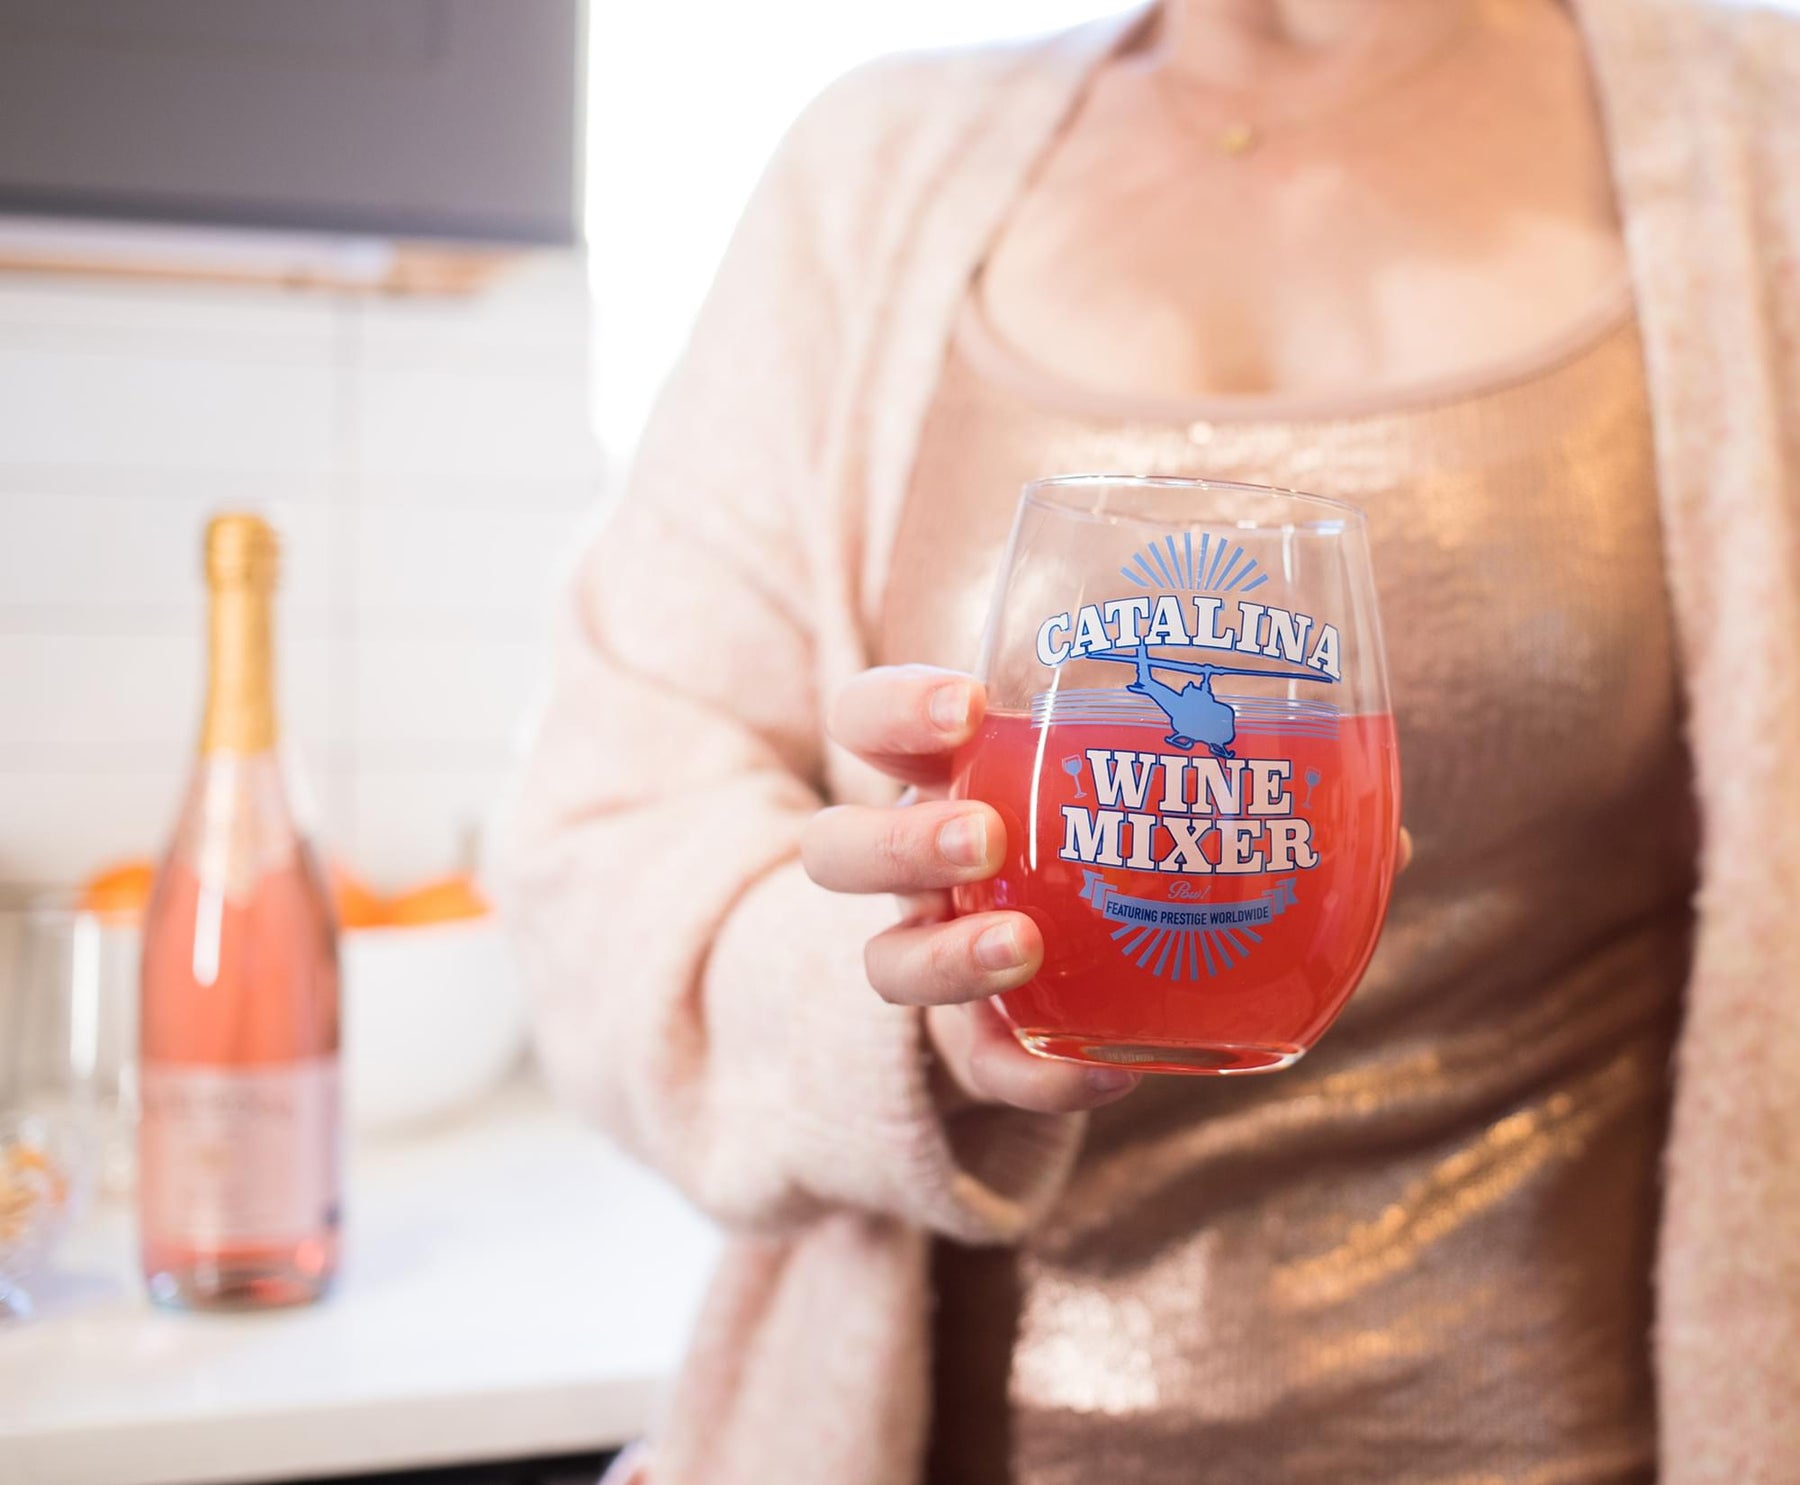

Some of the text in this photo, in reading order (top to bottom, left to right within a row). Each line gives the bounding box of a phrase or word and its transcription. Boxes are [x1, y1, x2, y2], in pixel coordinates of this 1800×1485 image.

[1037, 595, 1341, 681] CATALINA
[1085, 748, 1293, 815] WINE
[1058, 804, 1319, 874] MIXER
[1106, 900, 1270, 925] FEATURING PRESTIGE WORLDWIDE
